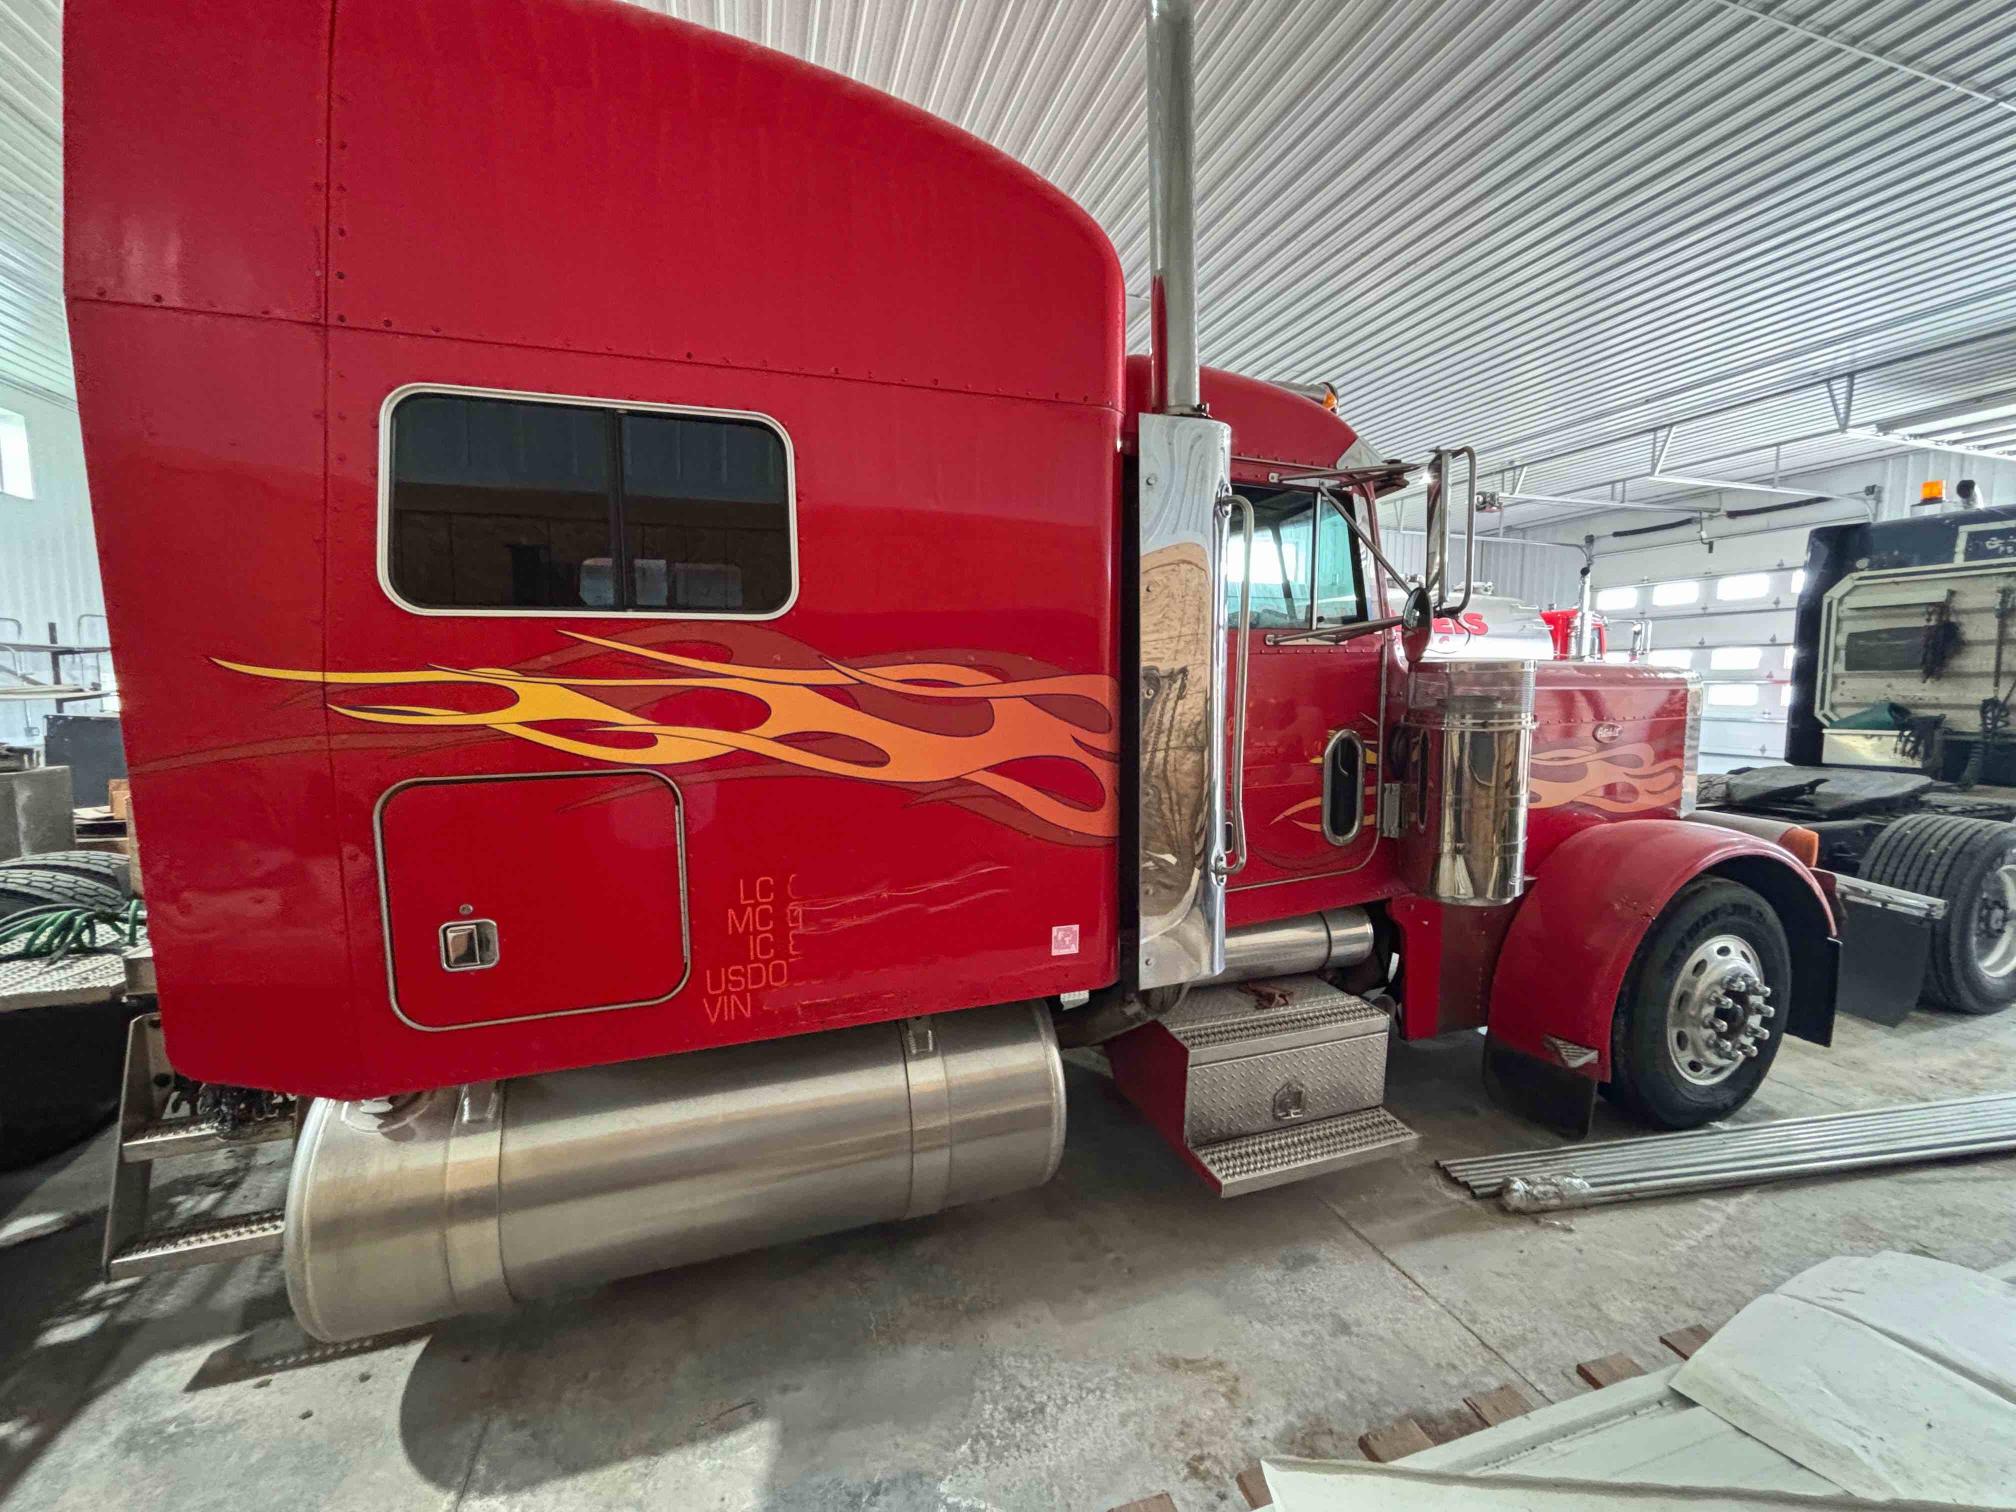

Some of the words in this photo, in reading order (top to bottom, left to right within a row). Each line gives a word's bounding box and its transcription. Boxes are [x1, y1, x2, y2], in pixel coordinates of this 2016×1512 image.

[740, 877, 774, 905] LC
[728, 905, 773, 935] MC
[750, 933, 774, 960] IC
[703, 993, 751, 1024] VIN
